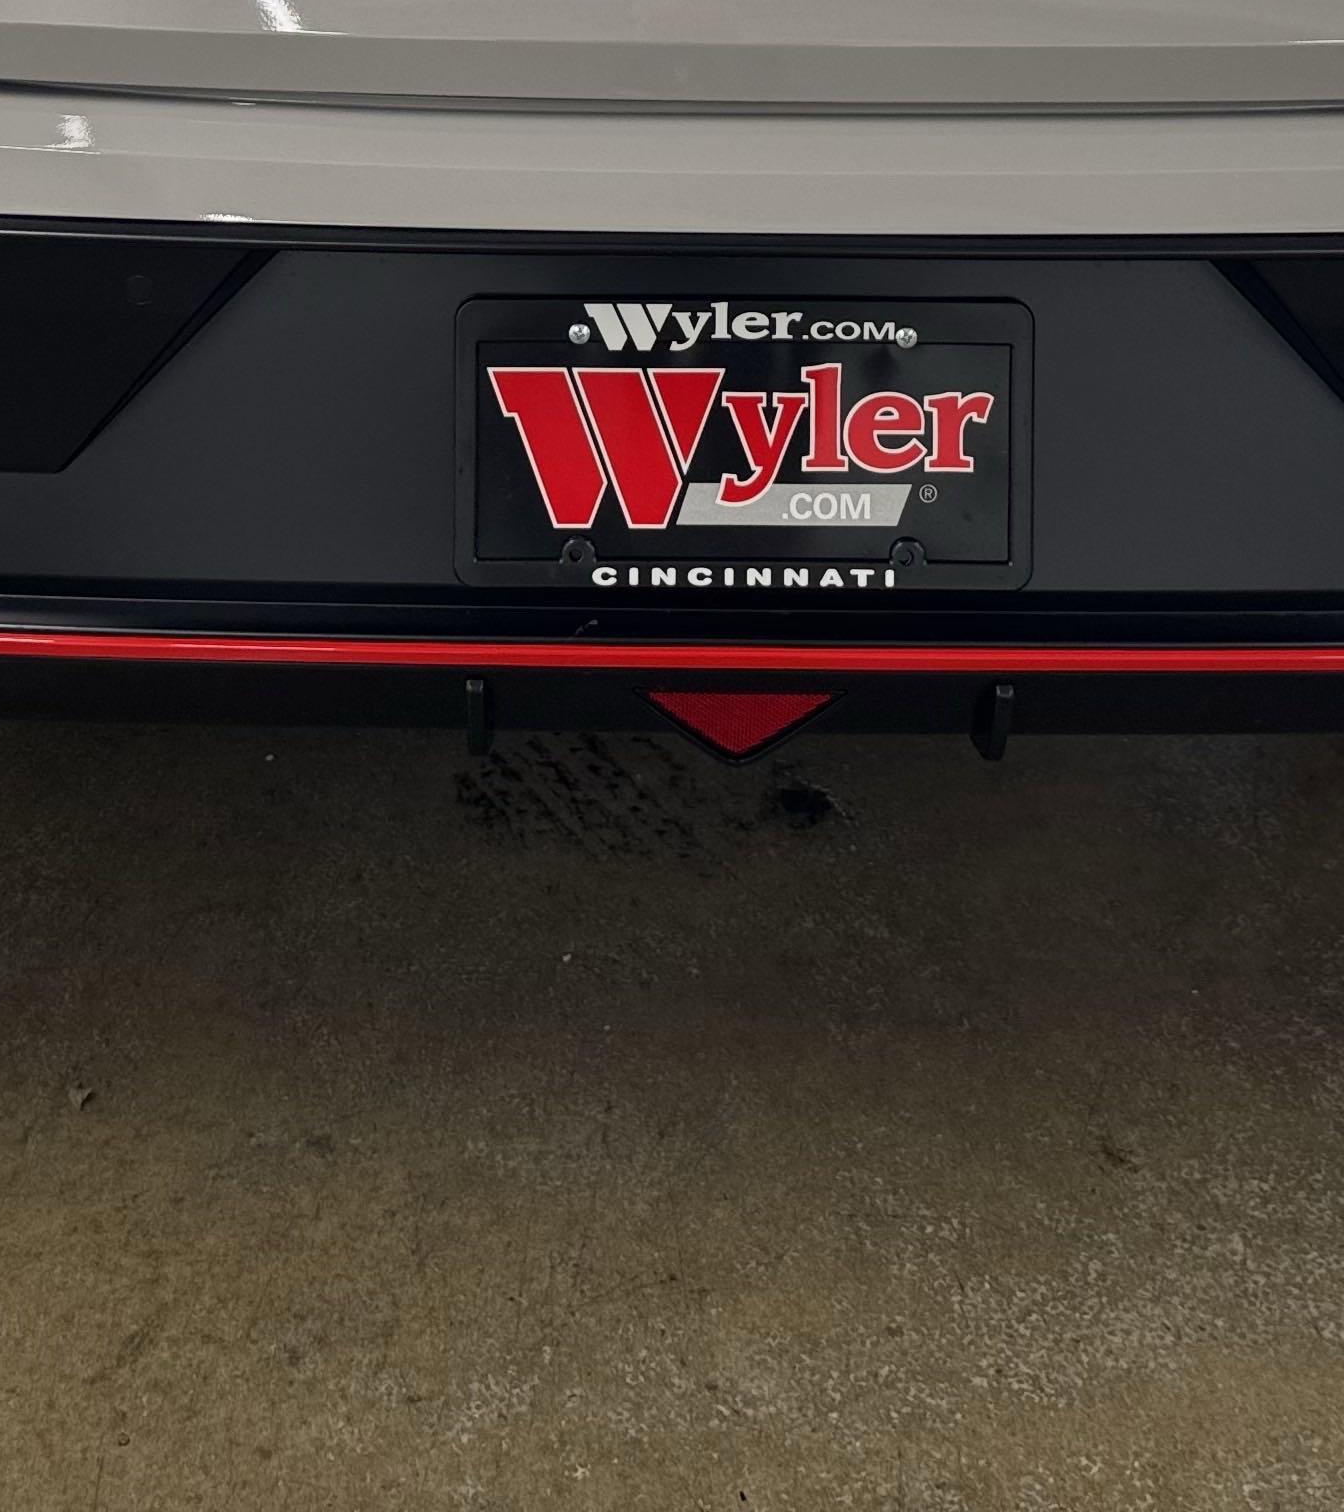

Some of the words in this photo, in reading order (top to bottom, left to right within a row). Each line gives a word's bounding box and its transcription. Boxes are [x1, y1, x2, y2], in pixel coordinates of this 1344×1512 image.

[486, 362, 995, 530] Wyler
[781, 491, 872, 521] .COM
[591, 565, 896, 589] CINCINNATI
